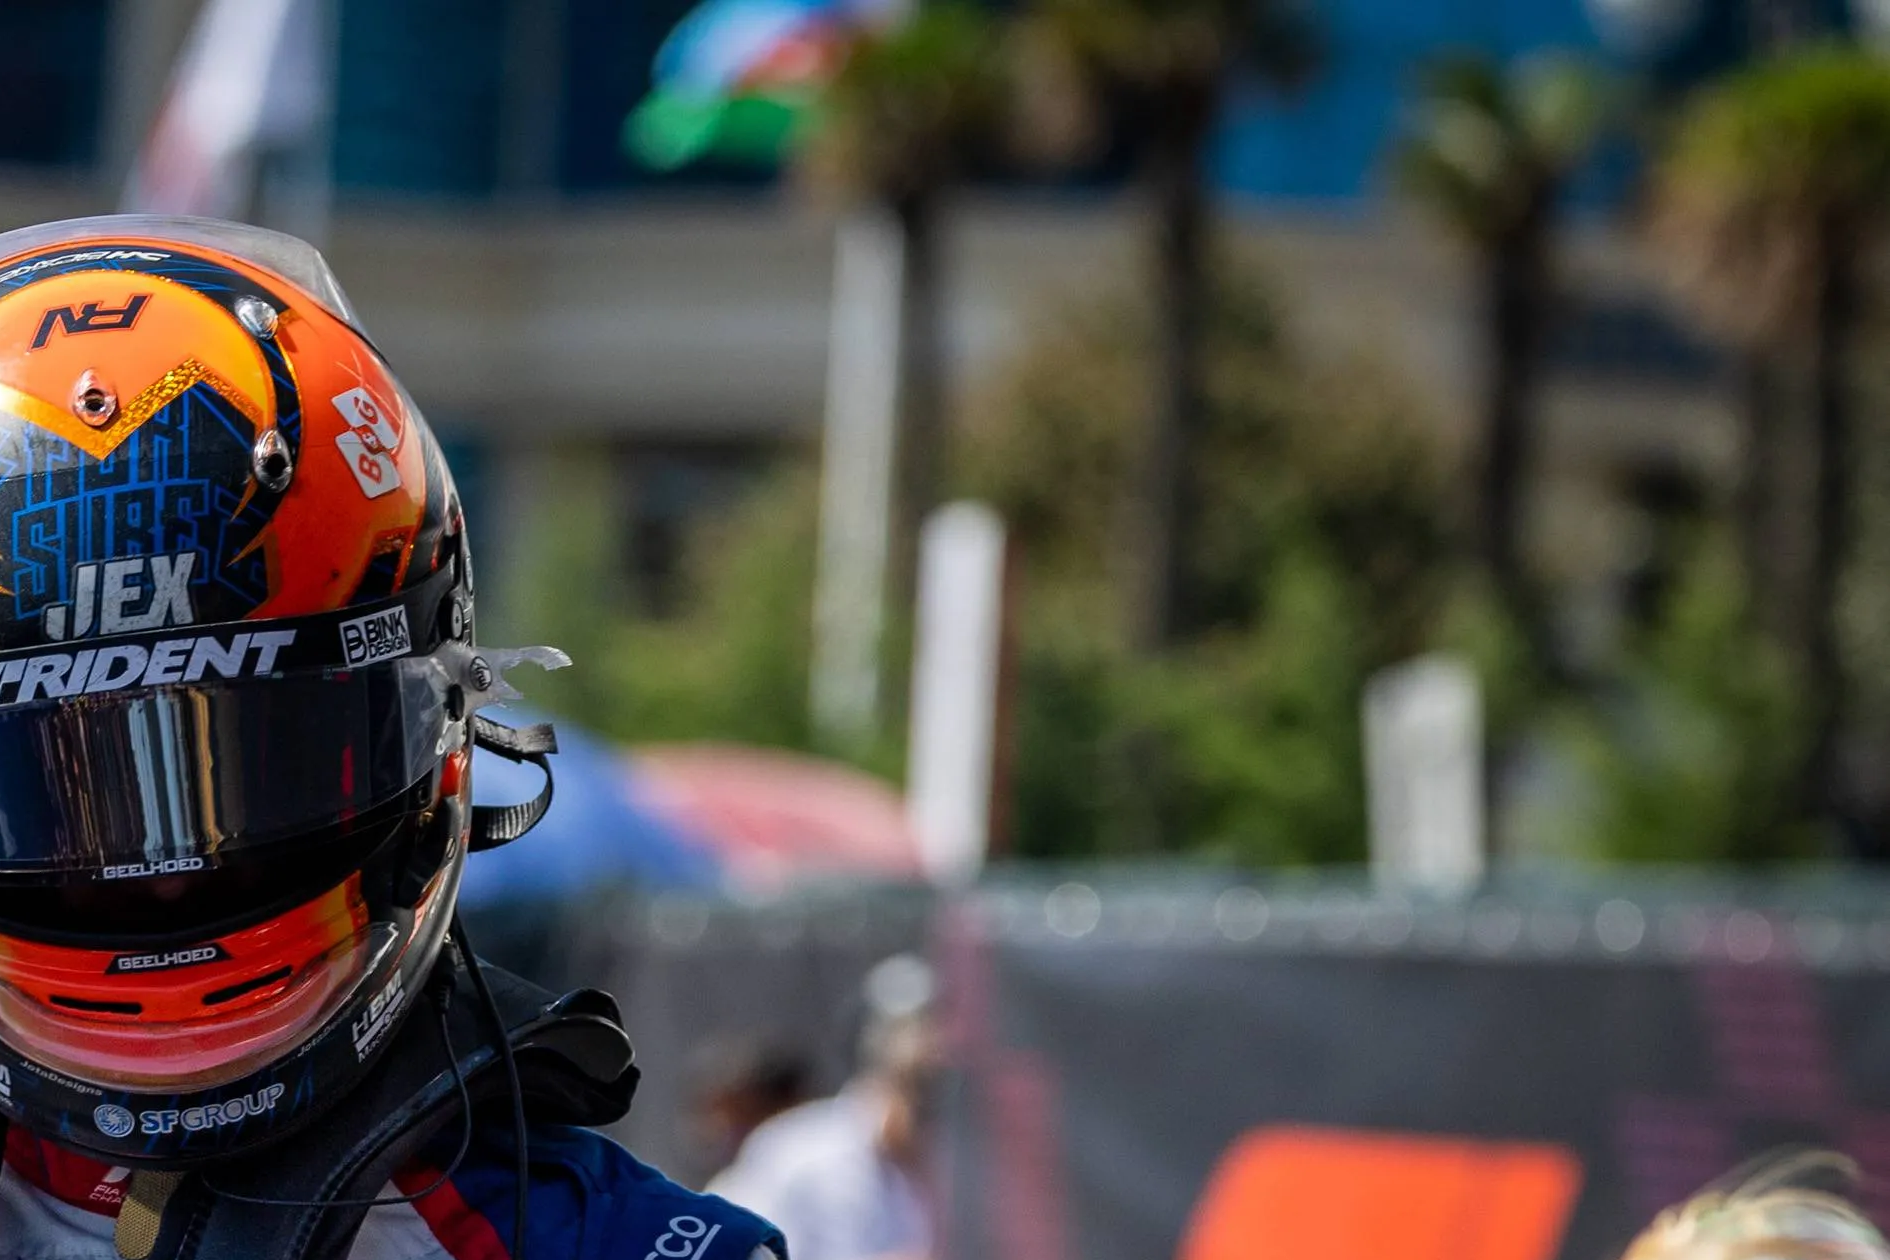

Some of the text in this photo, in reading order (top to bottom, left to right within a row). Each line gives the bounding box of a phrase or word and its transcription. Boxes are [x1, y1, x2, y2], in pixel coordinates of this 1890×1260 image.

[44, 552, 196, 640] JEX
[363, 610, 407, 643] BINK
[368, 634, 410, 659] DESIGN
[103, 857, 204, 879] GEELHOED
[118, 947, 217, 970] GEELHOED
[352, 968, 402, 1043] HBM
